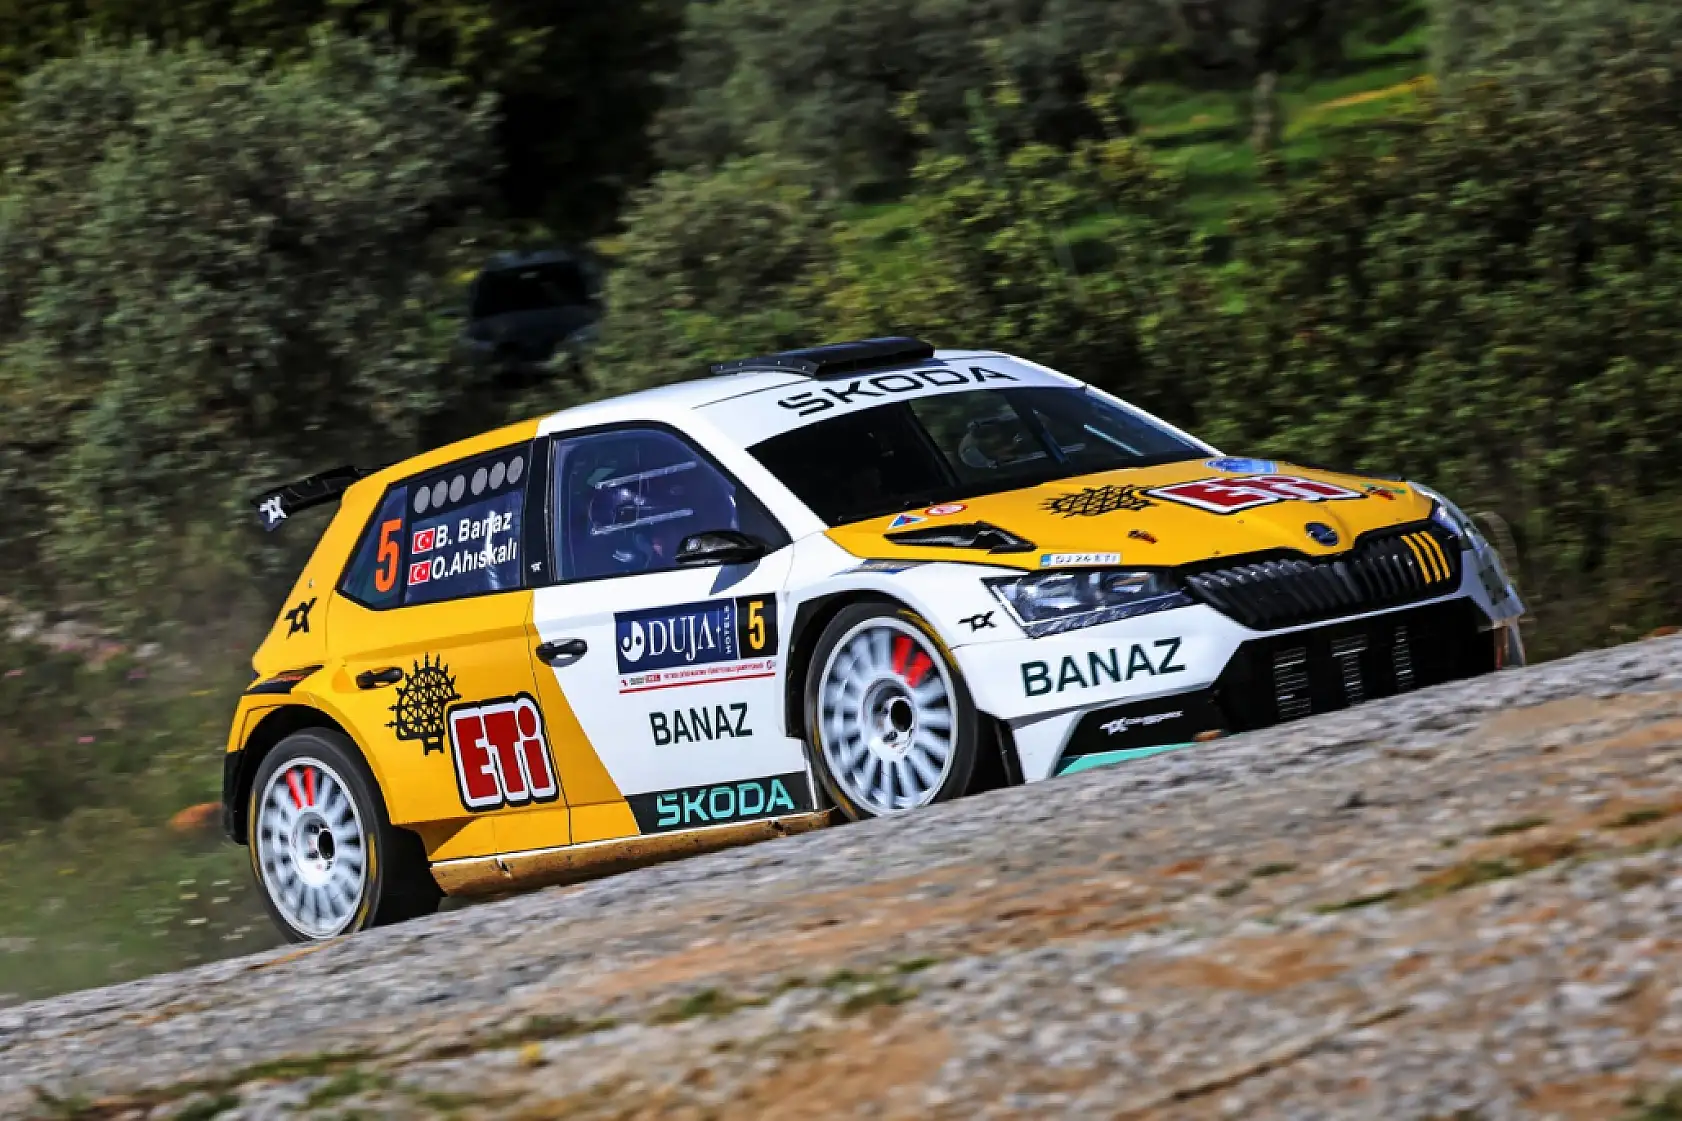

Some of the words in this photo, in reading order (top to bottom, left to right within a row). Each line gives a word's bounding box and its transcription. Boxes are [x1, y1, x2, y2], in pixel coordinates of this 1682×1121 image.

[374, 518, 403, 593] 5
[435, 524, 453, 548] B.
[648, 613, 716, 661] DUJA
[748, 600, 765, 650] 5
[1020, 636, 1187, 698] BANAZ
[648, 702, 753, 746] BANAZ
